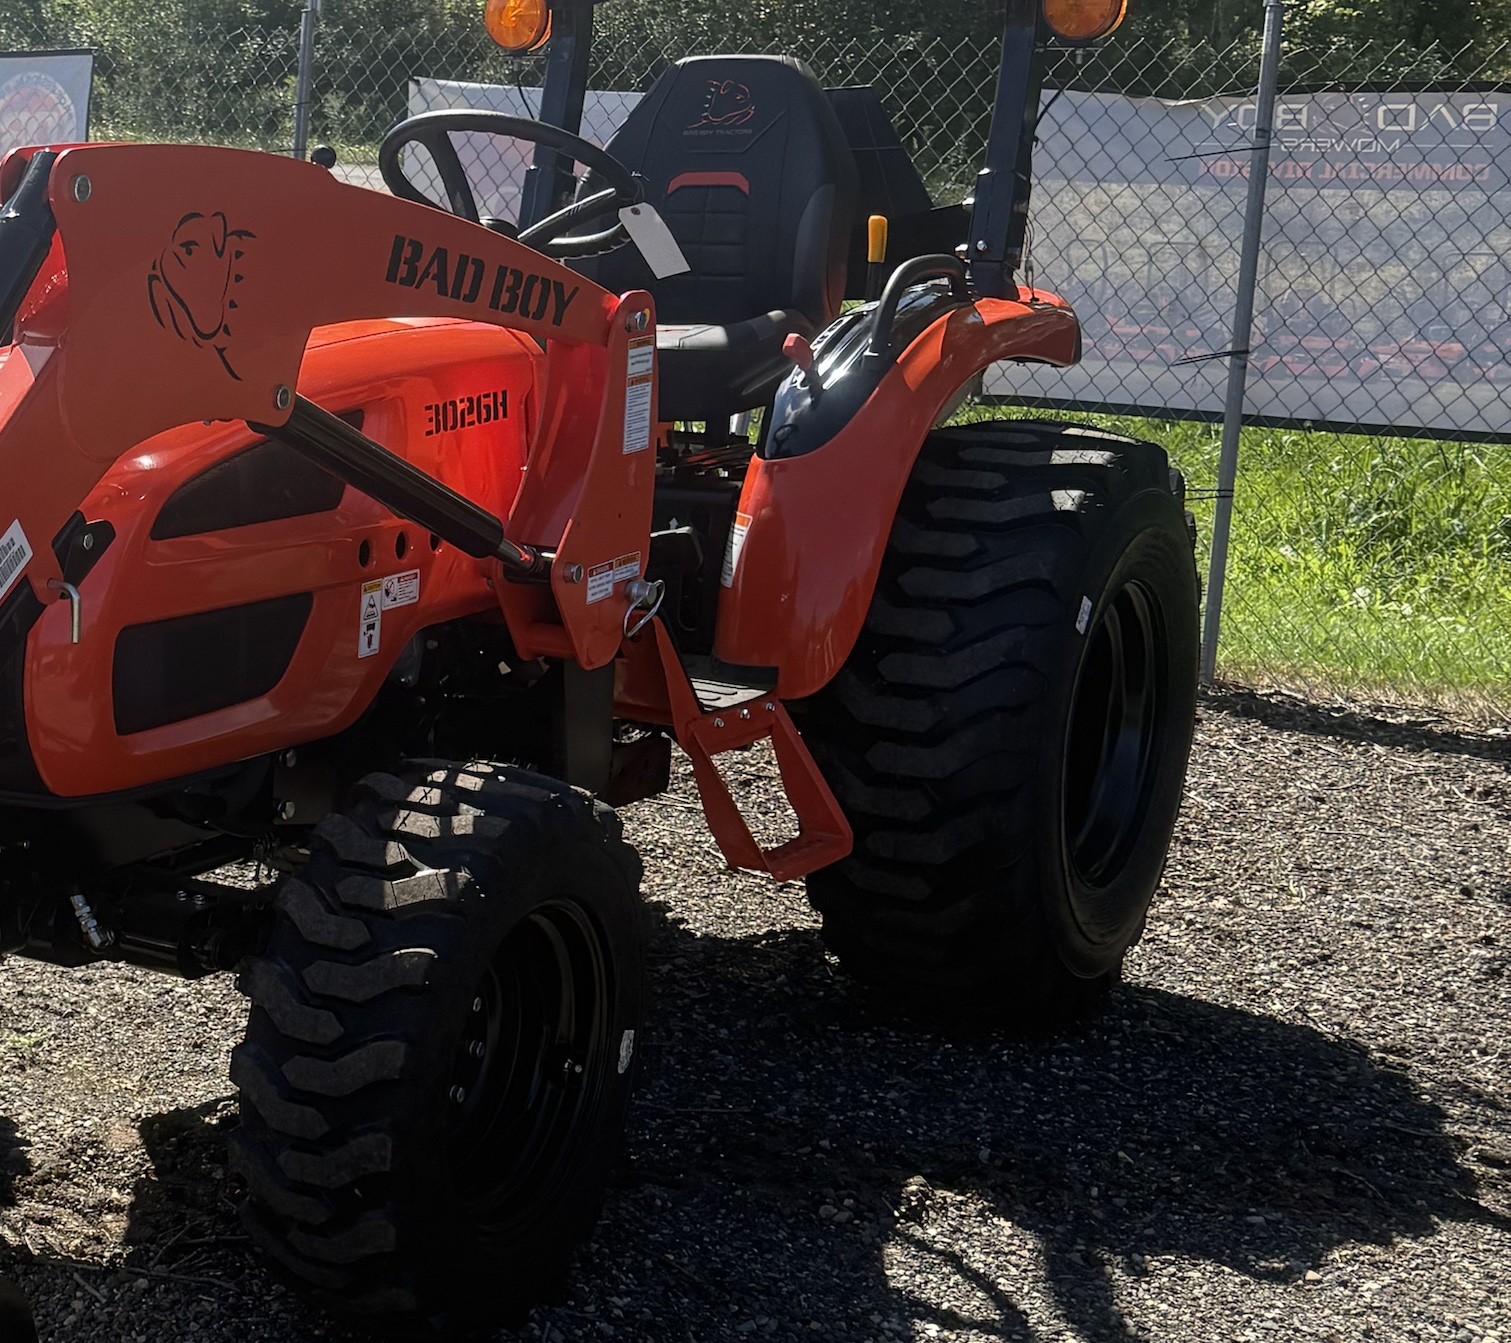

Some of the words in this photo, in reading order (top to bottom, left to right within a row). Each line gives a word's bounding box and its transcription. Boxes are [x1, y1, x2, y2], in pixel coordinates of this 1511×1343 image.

[385, 234, 486, 304] BAD
[488, 264, 579, 327] BOY
[424, 389, 508, 437] 3026H
